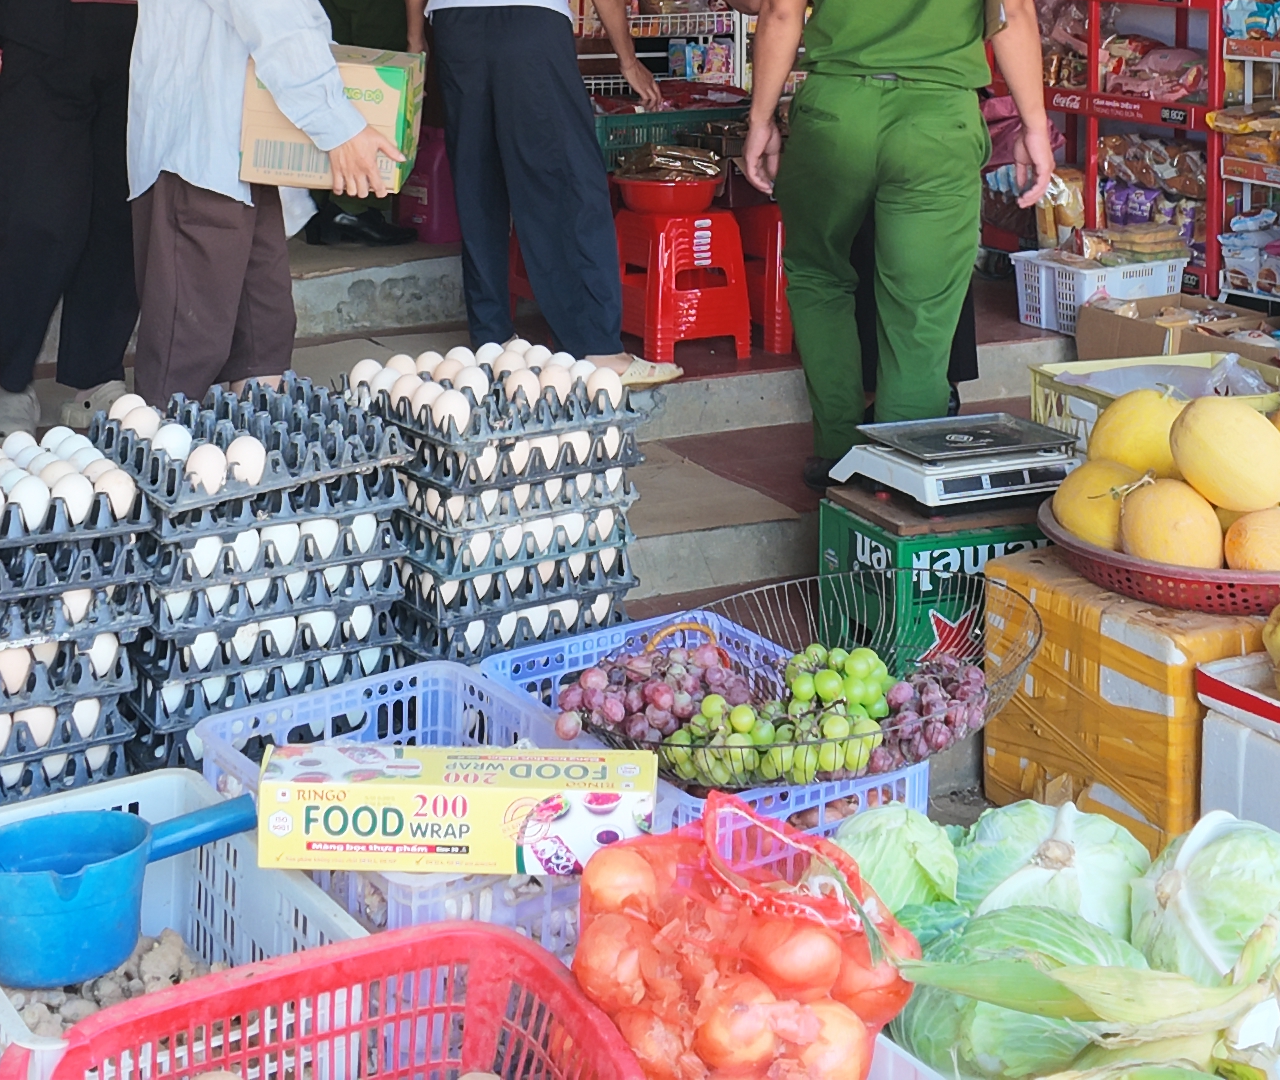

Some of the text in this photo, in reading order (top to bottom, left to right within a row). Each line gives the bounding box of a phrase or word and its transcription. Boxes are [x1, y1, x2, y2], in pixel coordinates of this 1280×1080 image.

[445, 758, 608, 780] FOOD WRAP
[443, 772, 498, 785] 200
[297, 789, 347, 802] RINGO
[413, 794, 468, 818] 200
[304, 805, 470, 839] FOOD WRAP
[312, 842, 344, 853] Màng
[346, 843, 367, 853] bọc
[368, 843, 393, 853] thực
[395, 842, 428, 855] phẩm
